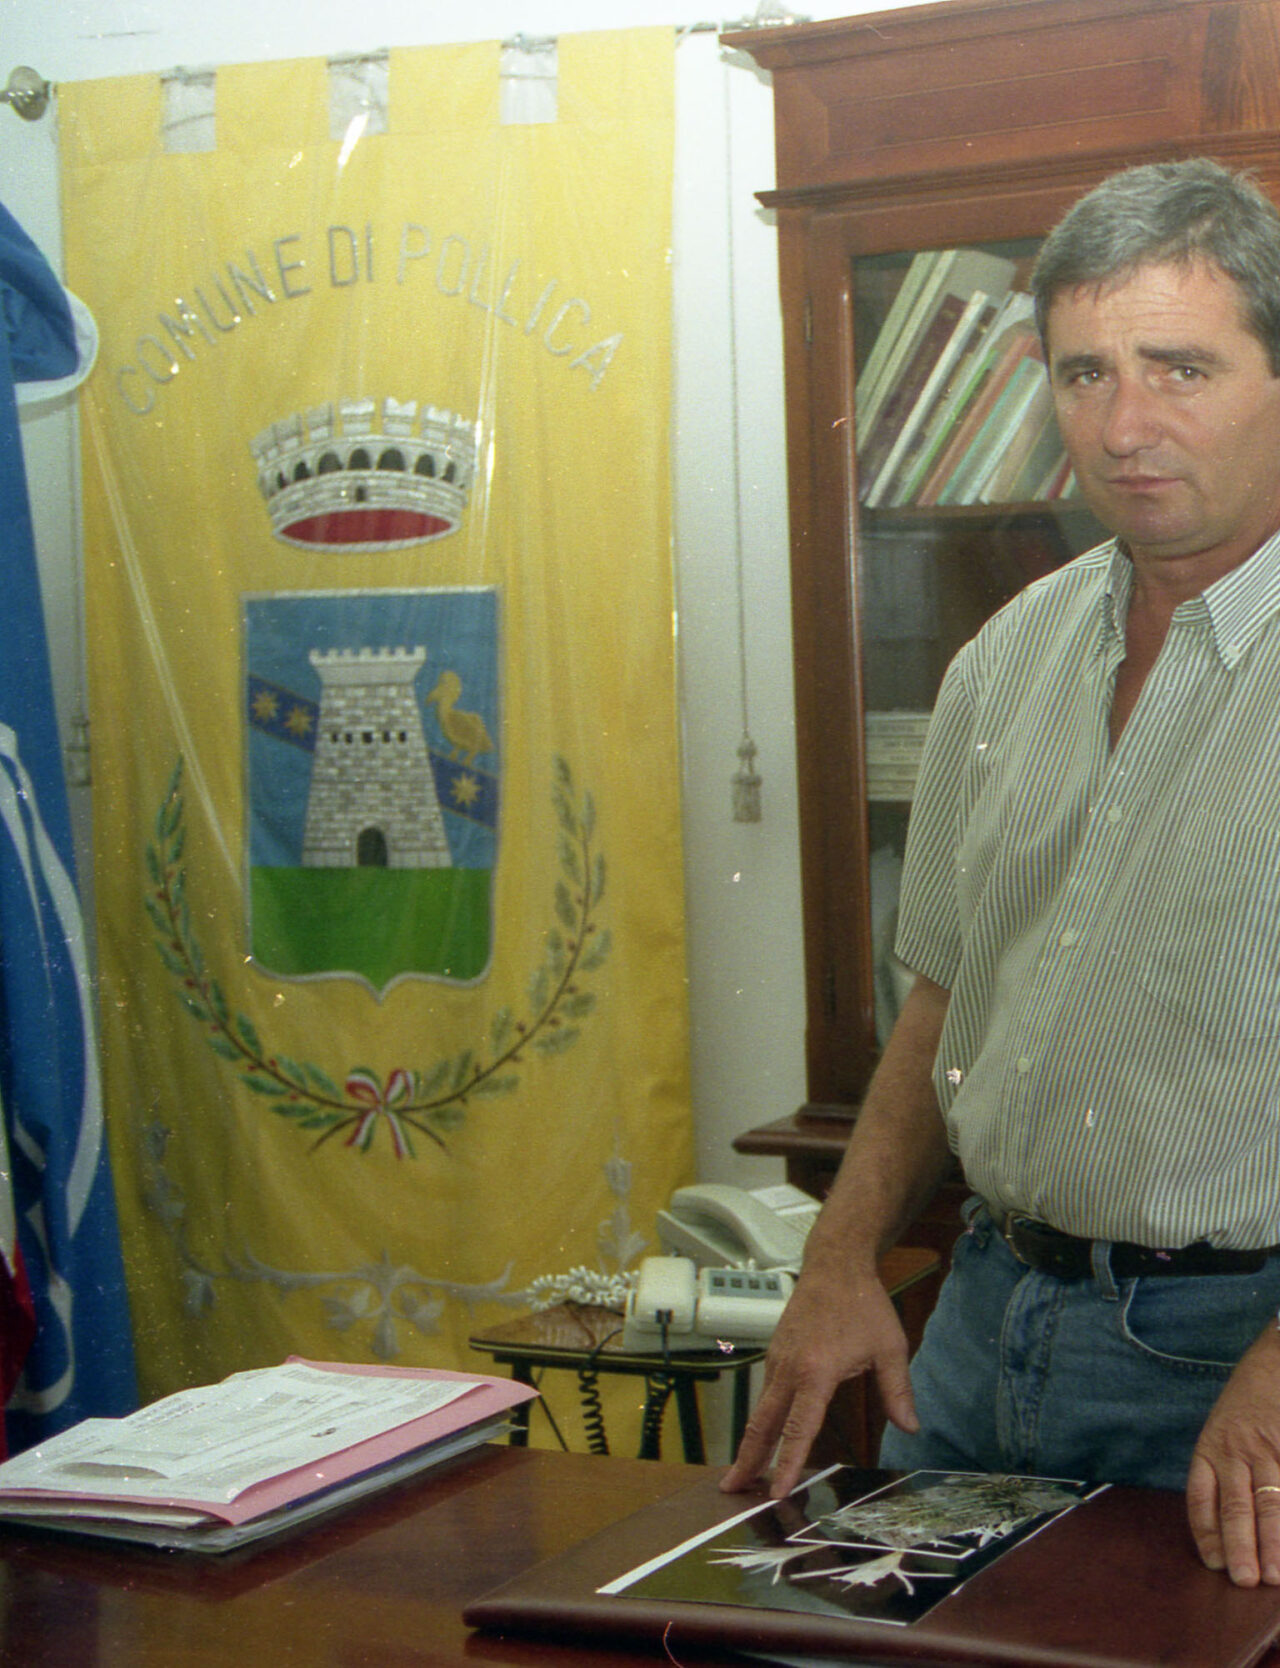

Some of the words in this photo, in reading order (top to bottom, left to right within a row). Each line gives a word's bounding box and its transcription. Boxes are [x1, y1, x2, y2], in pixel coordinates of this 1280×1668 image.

[117, 234, 312, 415] COMUNE
[328, 221, 373, 287] DI
[397, 222, 625, 392] POLLICA
